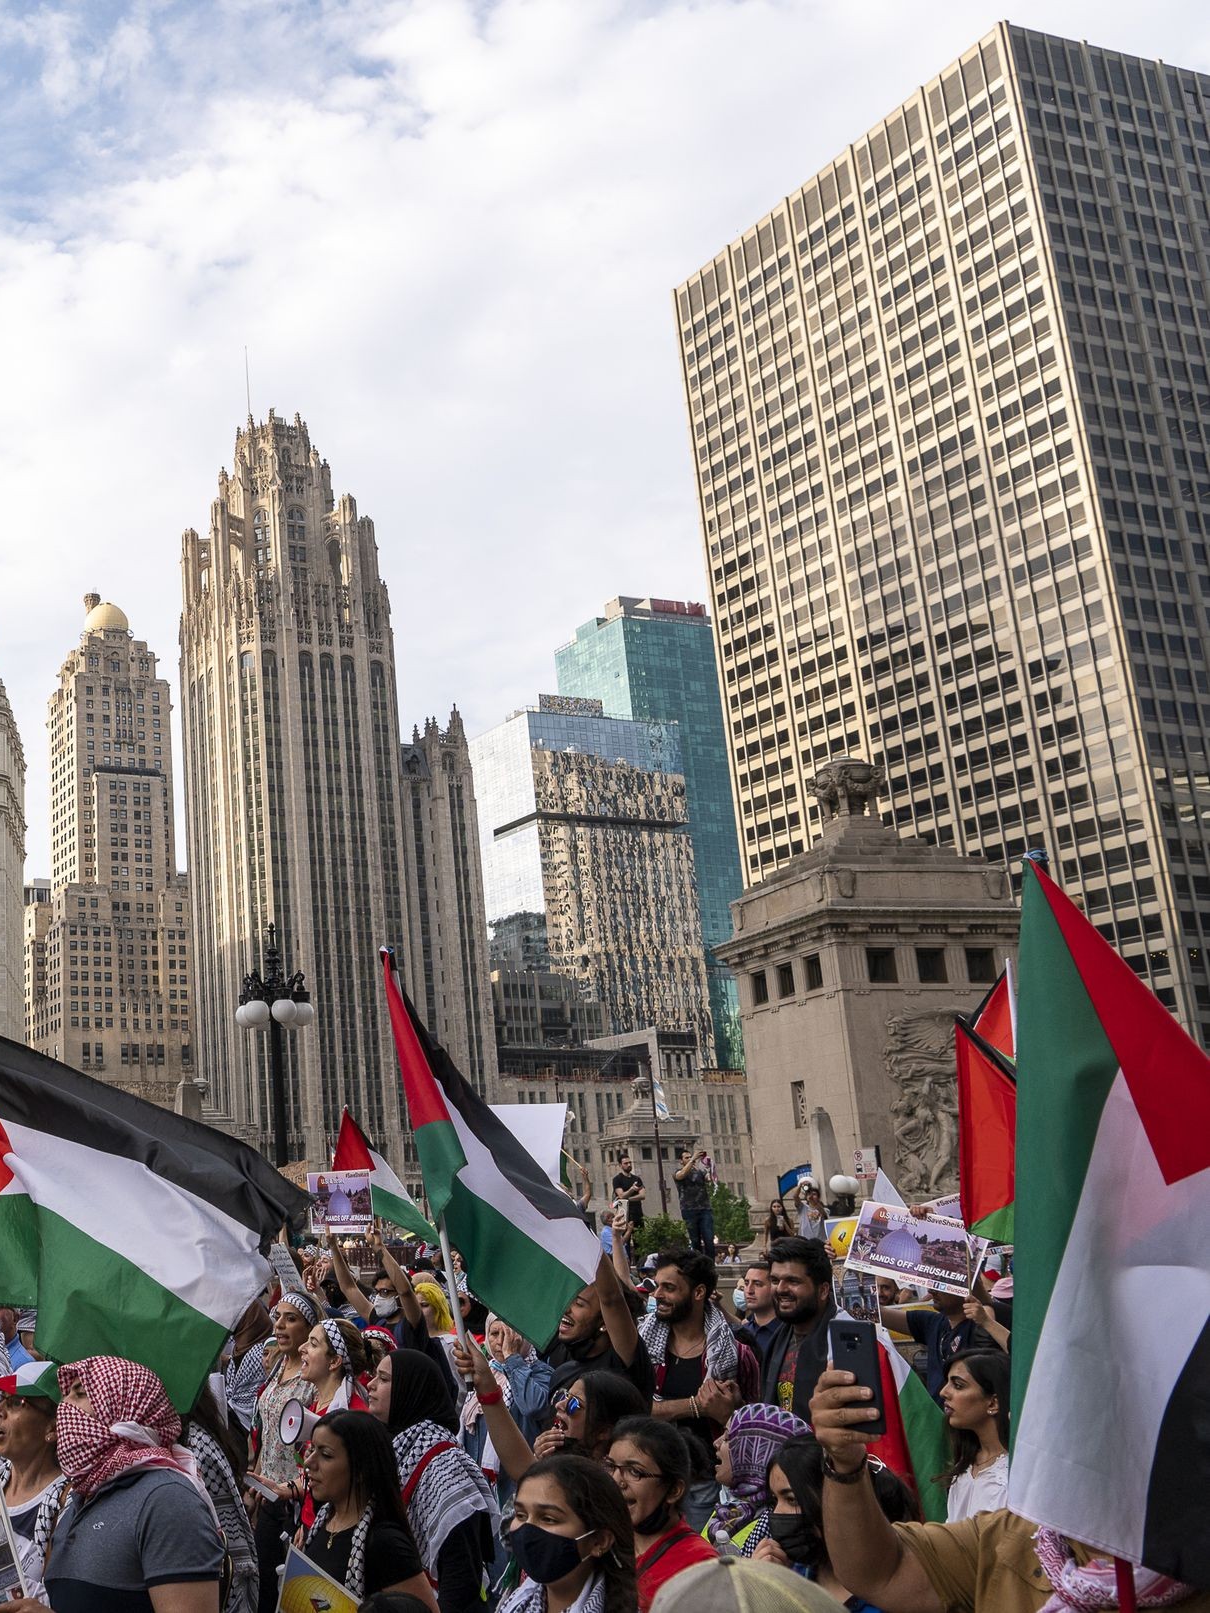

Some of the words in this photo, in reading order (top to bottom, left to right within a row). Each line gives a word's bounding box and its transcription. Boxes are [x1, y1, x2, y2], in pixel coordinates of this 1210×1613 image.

[936, 1194, 961, 1207] #SaveS
[879, 1211, 890, 1220] U.S.
[869, 1252, 895, 1265] HANDS
[897, 1258, 913, 1270] OFF
[913, 1262, 967, 1283] JERUSALEM!
[899, 1274, 926, 1286] uspcn.org
